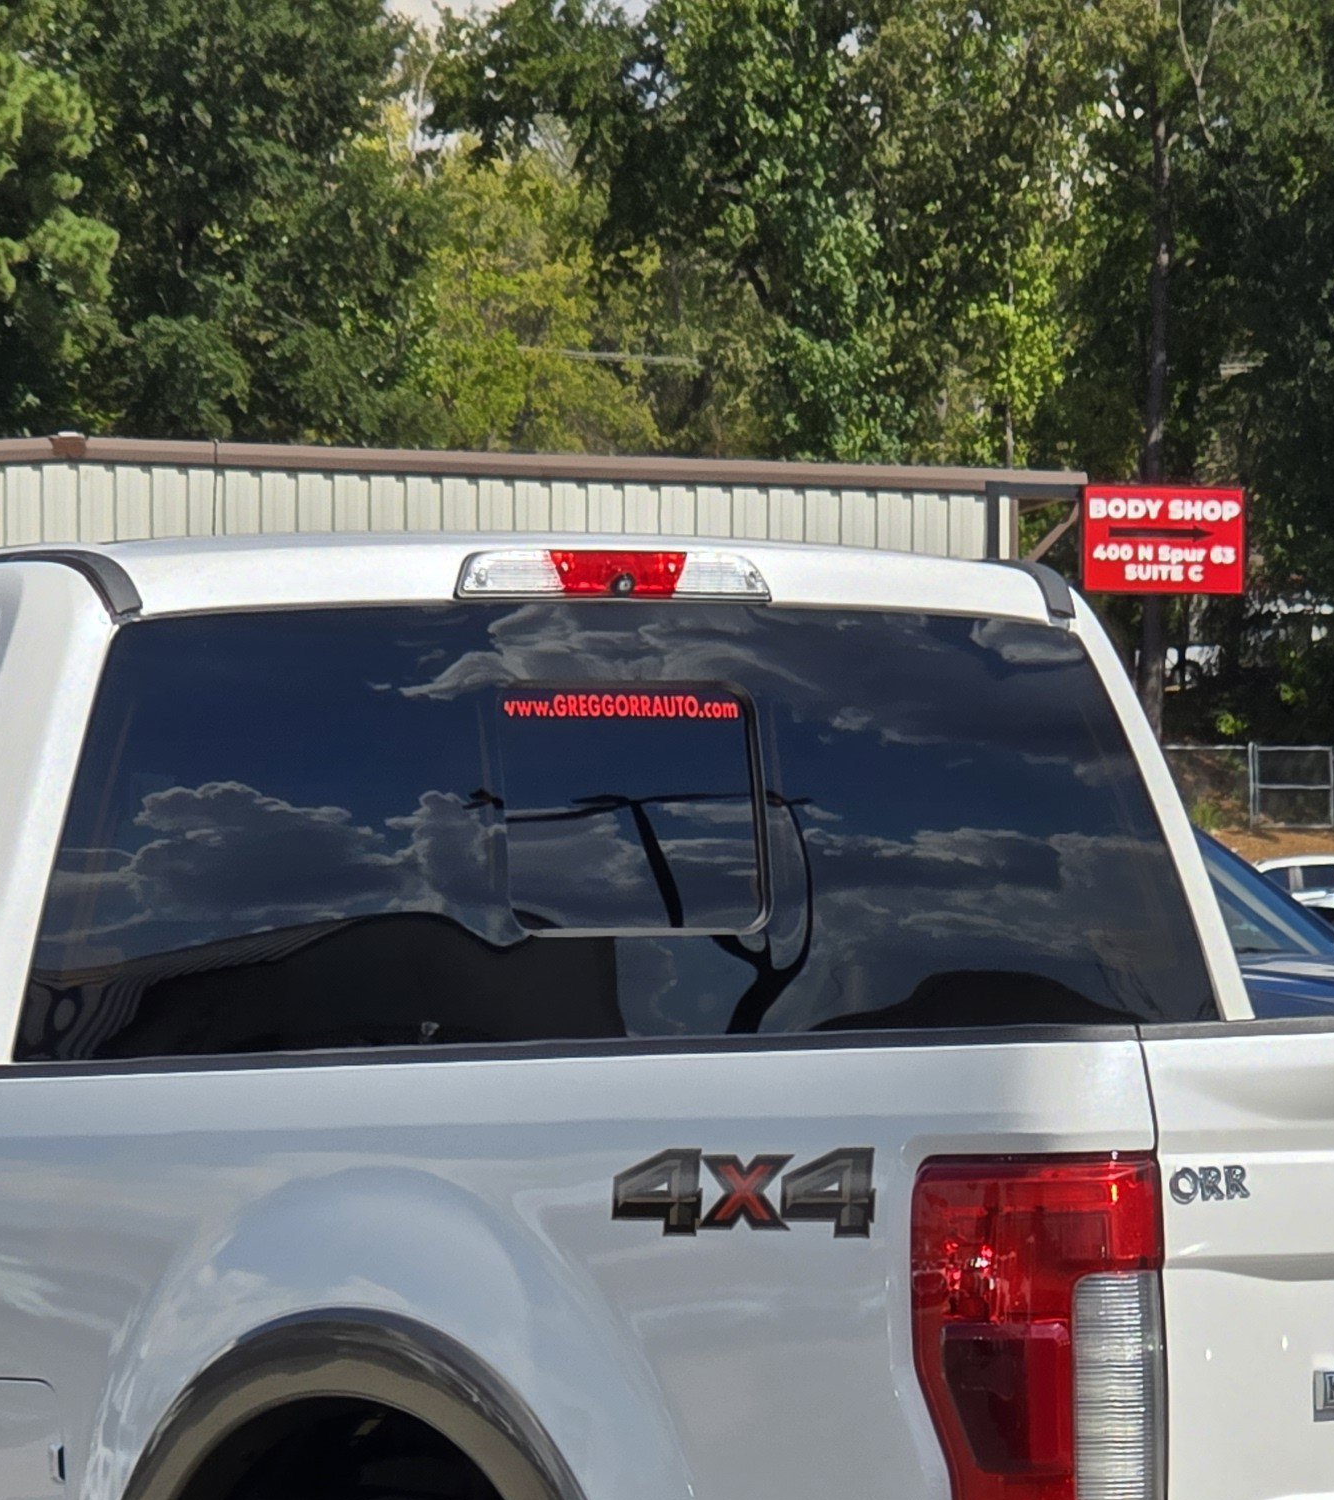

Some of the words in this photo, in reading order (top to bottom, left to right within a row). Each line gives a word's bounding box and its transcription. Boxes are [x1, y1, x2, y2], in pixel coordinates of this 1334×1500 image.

[1089, 498, 1163, 519] BODY
[1168, 499, 1241, 521] SHOP
[1092, 543, 1134, 561] 400
[1138, 544, 1154, 561] N
[1158, 544, 1206, 565] Spur
[1125, 563, 1184, 582] SUITE
[1188, 564, 1204, 582] C
[503, 694, 739, 718] www.GREGGORRAUTO.com
[1169, 1165, 1251, 1205] ORR
